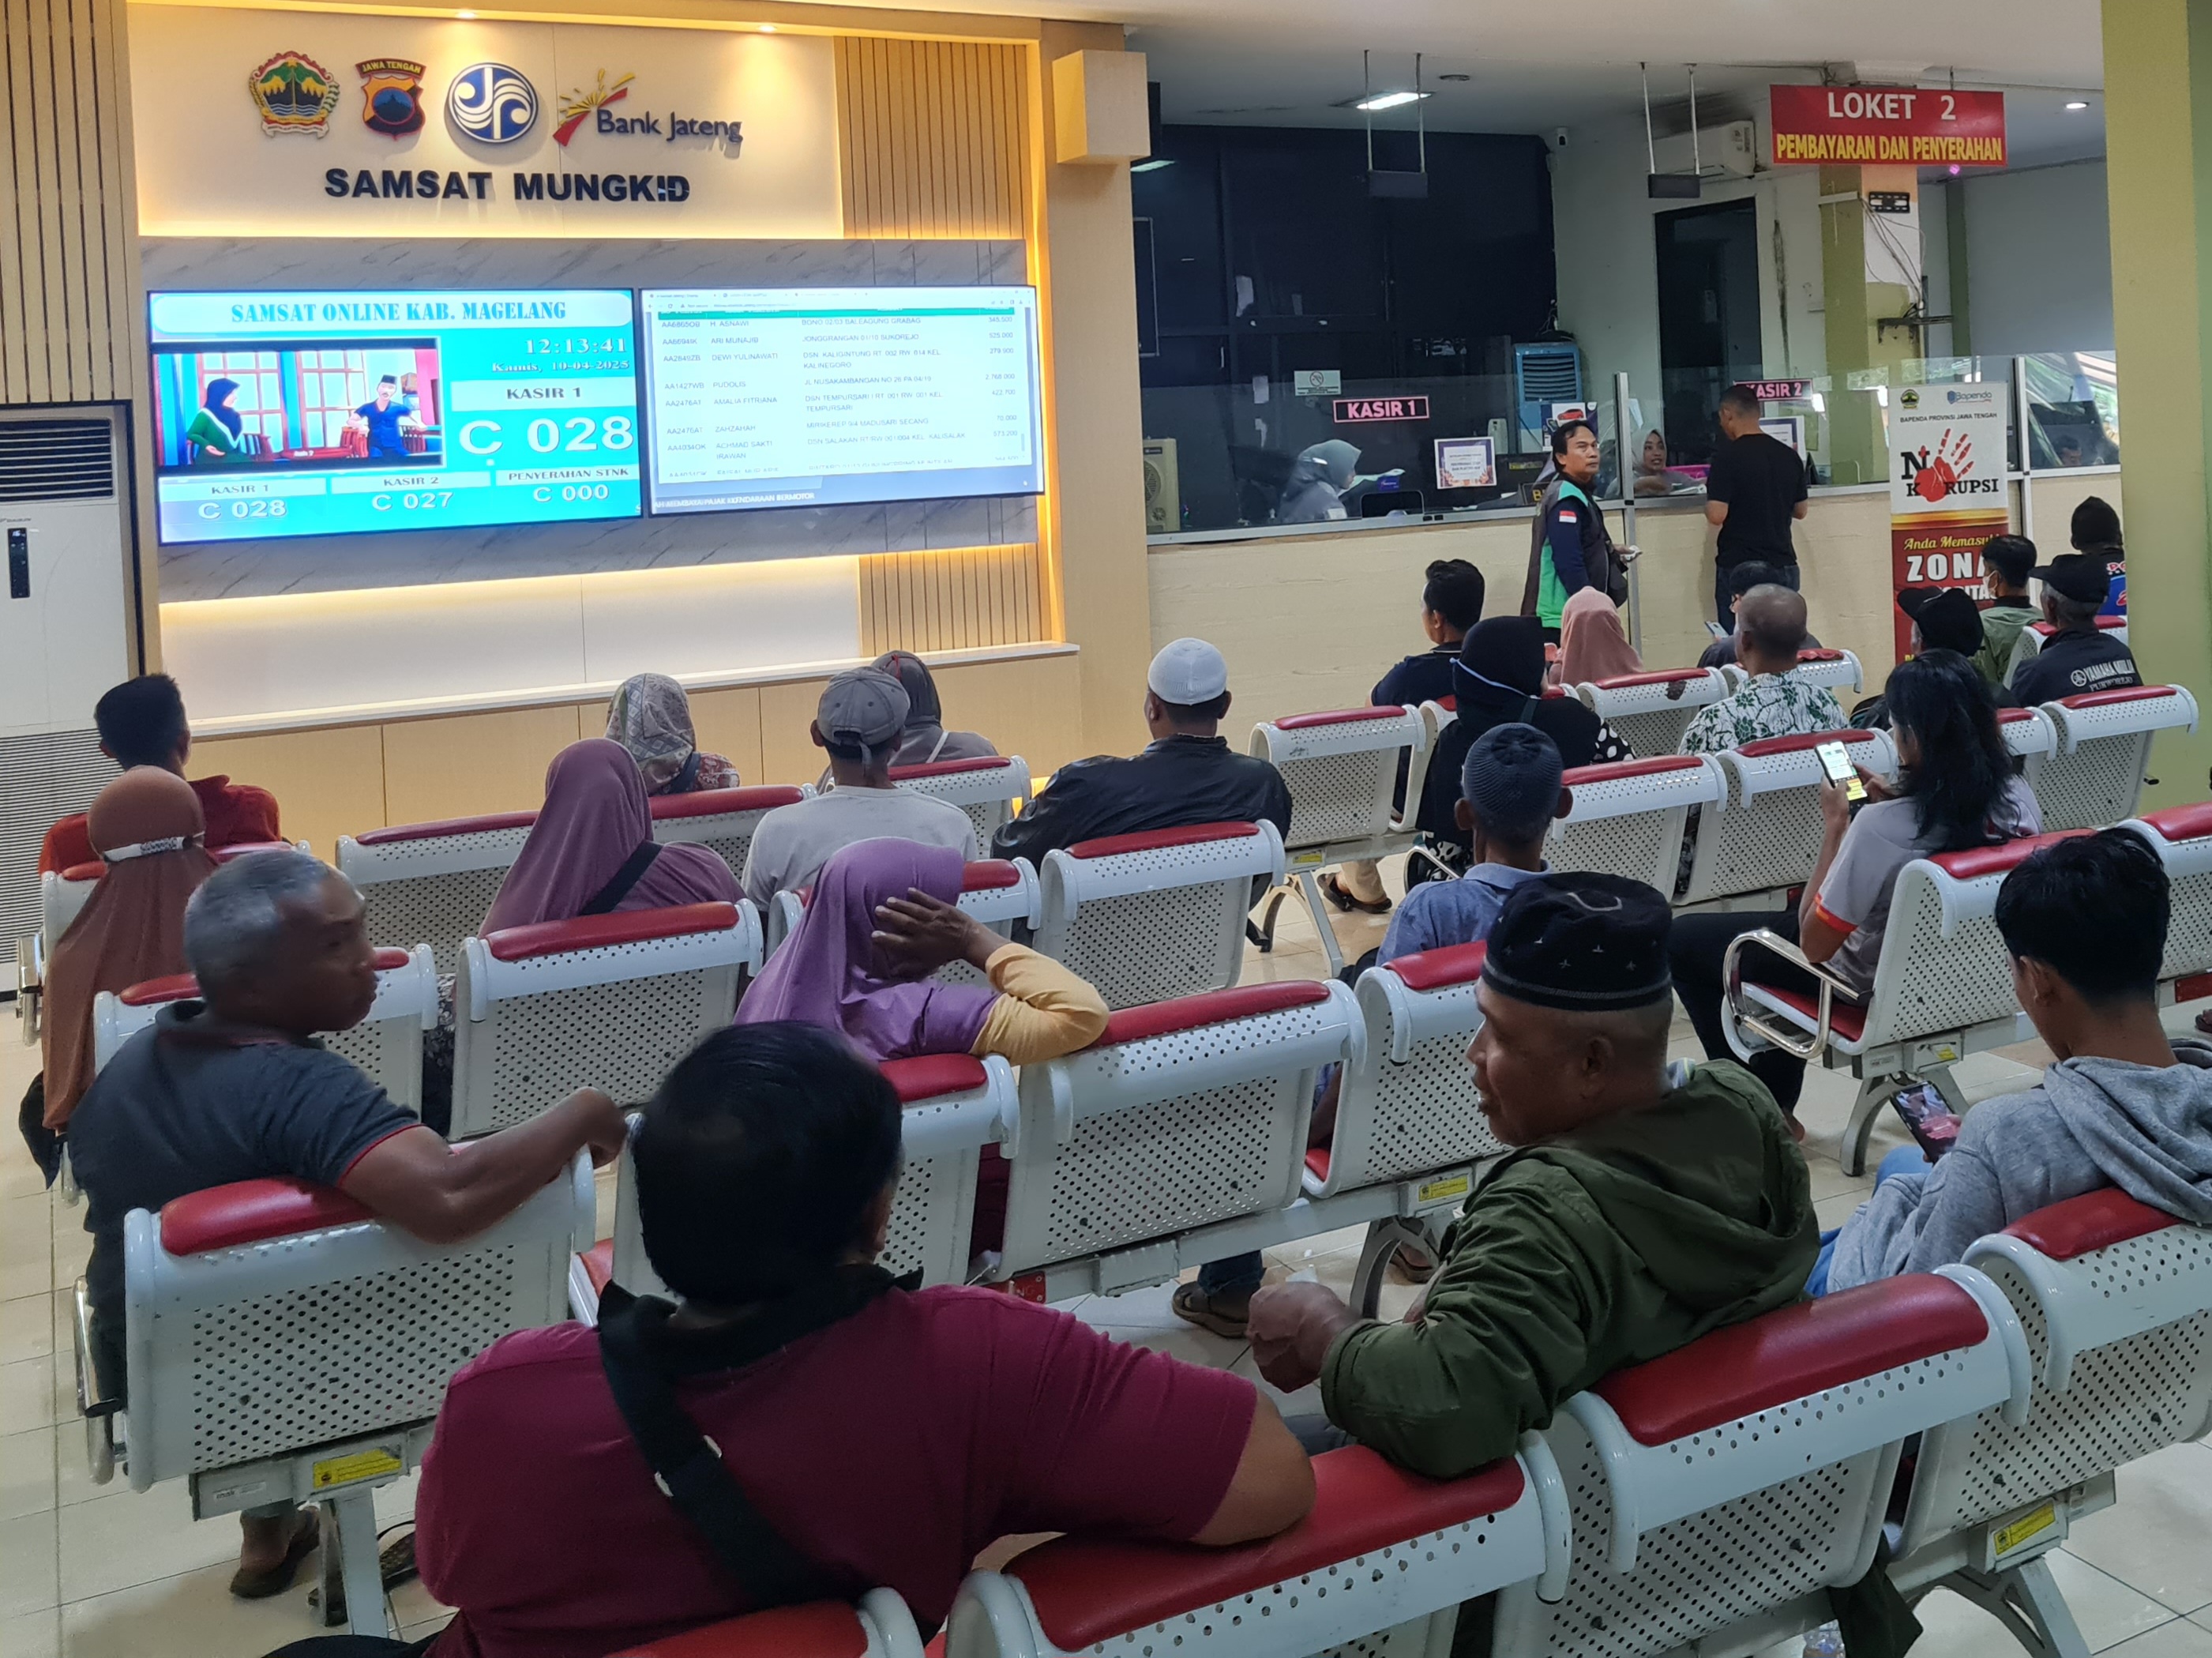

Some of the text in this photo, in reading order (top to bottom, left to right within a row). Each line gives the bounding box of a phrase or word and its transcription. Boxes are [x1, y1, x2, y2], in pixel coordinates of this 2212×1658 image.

[362, 61, 421, 73] JAWA TENGAH
[1827, 92, 1956, 120] LOKET 2
[595, 110, 743, 143] Bank Jateng
[1777, 133, 1876, 160] PEMBAYARAN
[1880, 135, 1910, 160] DAN
[1913, 136, 2002, 161] PENYERAHAN
[325, 168, 690, 201] SAMSAT MUNGKID
[231, 302, 566, 322] SAMSAT ONLINE KAB. MAGELANG
[526, 338, 626, 354] 12:13:41
[492, 360, 630, 373] Kamis, 10-04-2025
[506, 387, 580, 400] KASIR 1
[1794, 382, 1802, 396] 2
[1955, 391, 1992, 400] Bapenda
[1347, 400, 1416, 419] KASIR 1
[460, 415, 634, 455] C 028
[383, 477, 425, 487] KASIR
[509, 470, 591, 480] PENYERAHAN
[211, 485, 255, 494] KASIR
[533, 483, 610, 502] C 000
[776, 492, 815, 501] BERMOTOR
[1906, 479, 1999, 497] KRUPSI
[197, 499, 287, 520] C 028
[371, 491, 453, 511] C 027
[1903, 533, 2000, 550] Anda Memasu
